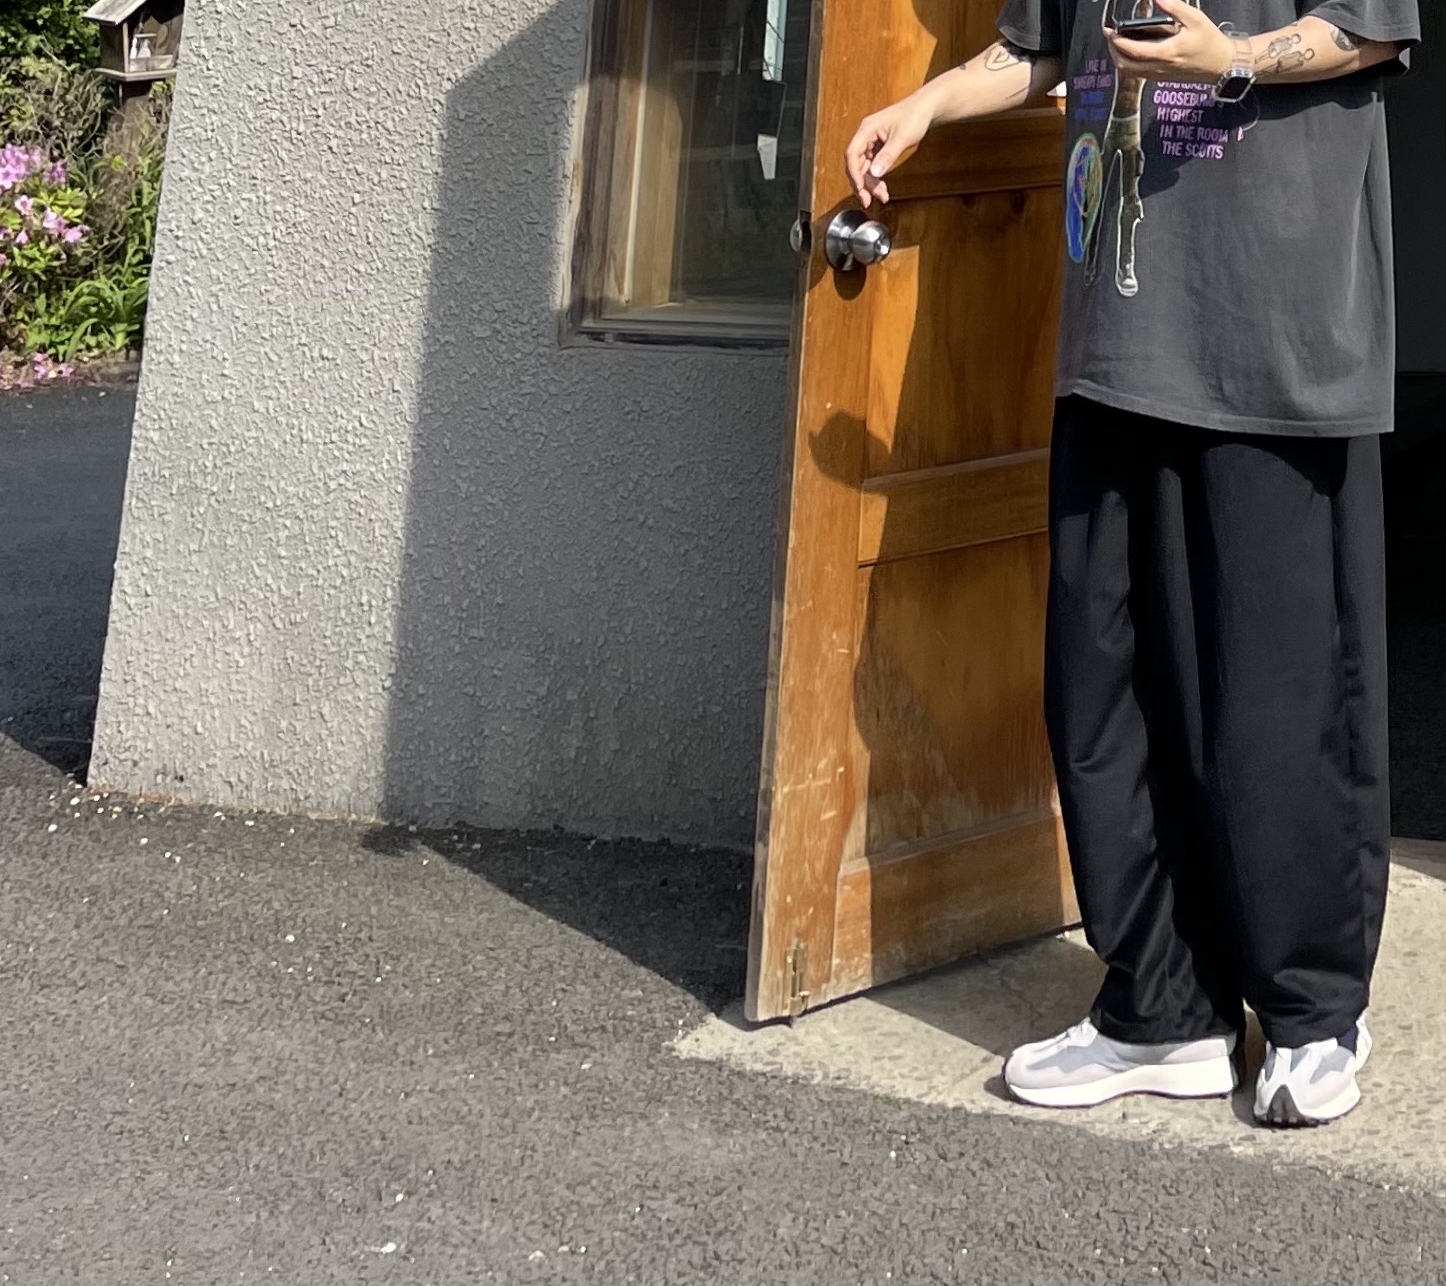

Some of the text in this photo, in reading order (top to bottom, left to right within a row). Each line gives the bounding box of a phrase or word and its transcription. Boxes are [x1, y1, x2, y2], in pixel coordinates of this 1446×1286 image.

[1157, 107, 1204, 123] HIGHEST
[1160, 124, 1229, 143] IN THE ROOM
[1162, 140, 1224, 160] THE SCOTTS
